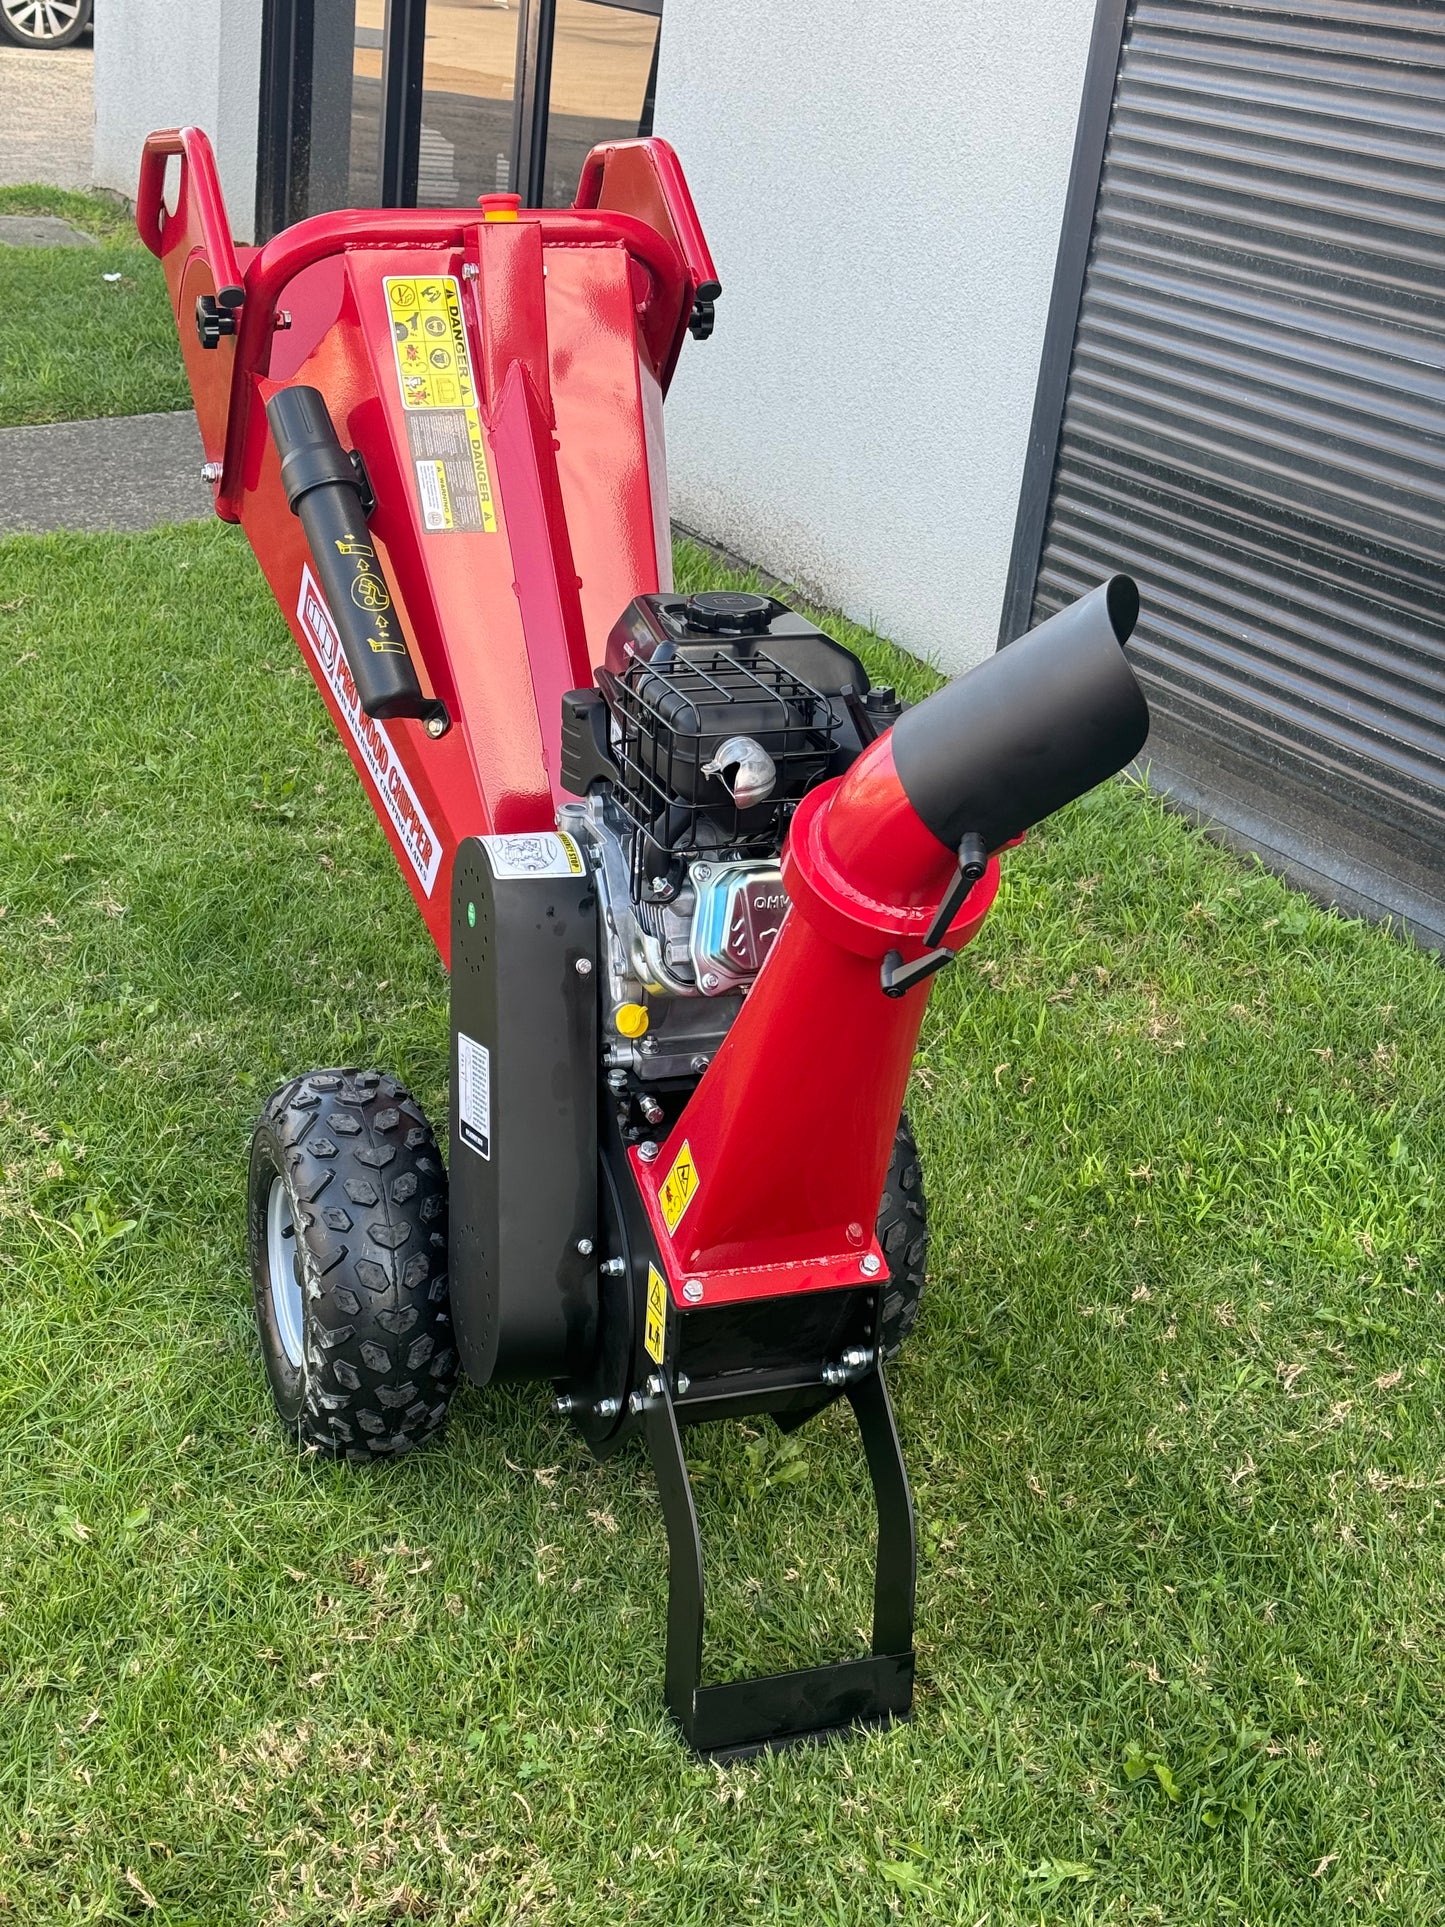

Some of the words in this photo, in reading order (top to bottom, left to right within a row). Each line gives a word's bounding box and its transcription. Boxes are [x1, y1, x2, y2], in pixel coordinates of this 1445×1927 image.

[449, 306, 469, 377] DANGER
[440, 477, 450, 513] WARNING
[471, 440, 490, 502] DANGER
[334, 680, 348, 710] TWIN
[347, 708, 379, 779] REVERSIBLE
[379, 778, 406, 835] CHIPPING
[405, 835, 428, 881] BLADES
[388, 765, 433, 871] CHIPPER
[569, 853, 580, 868] STOP
